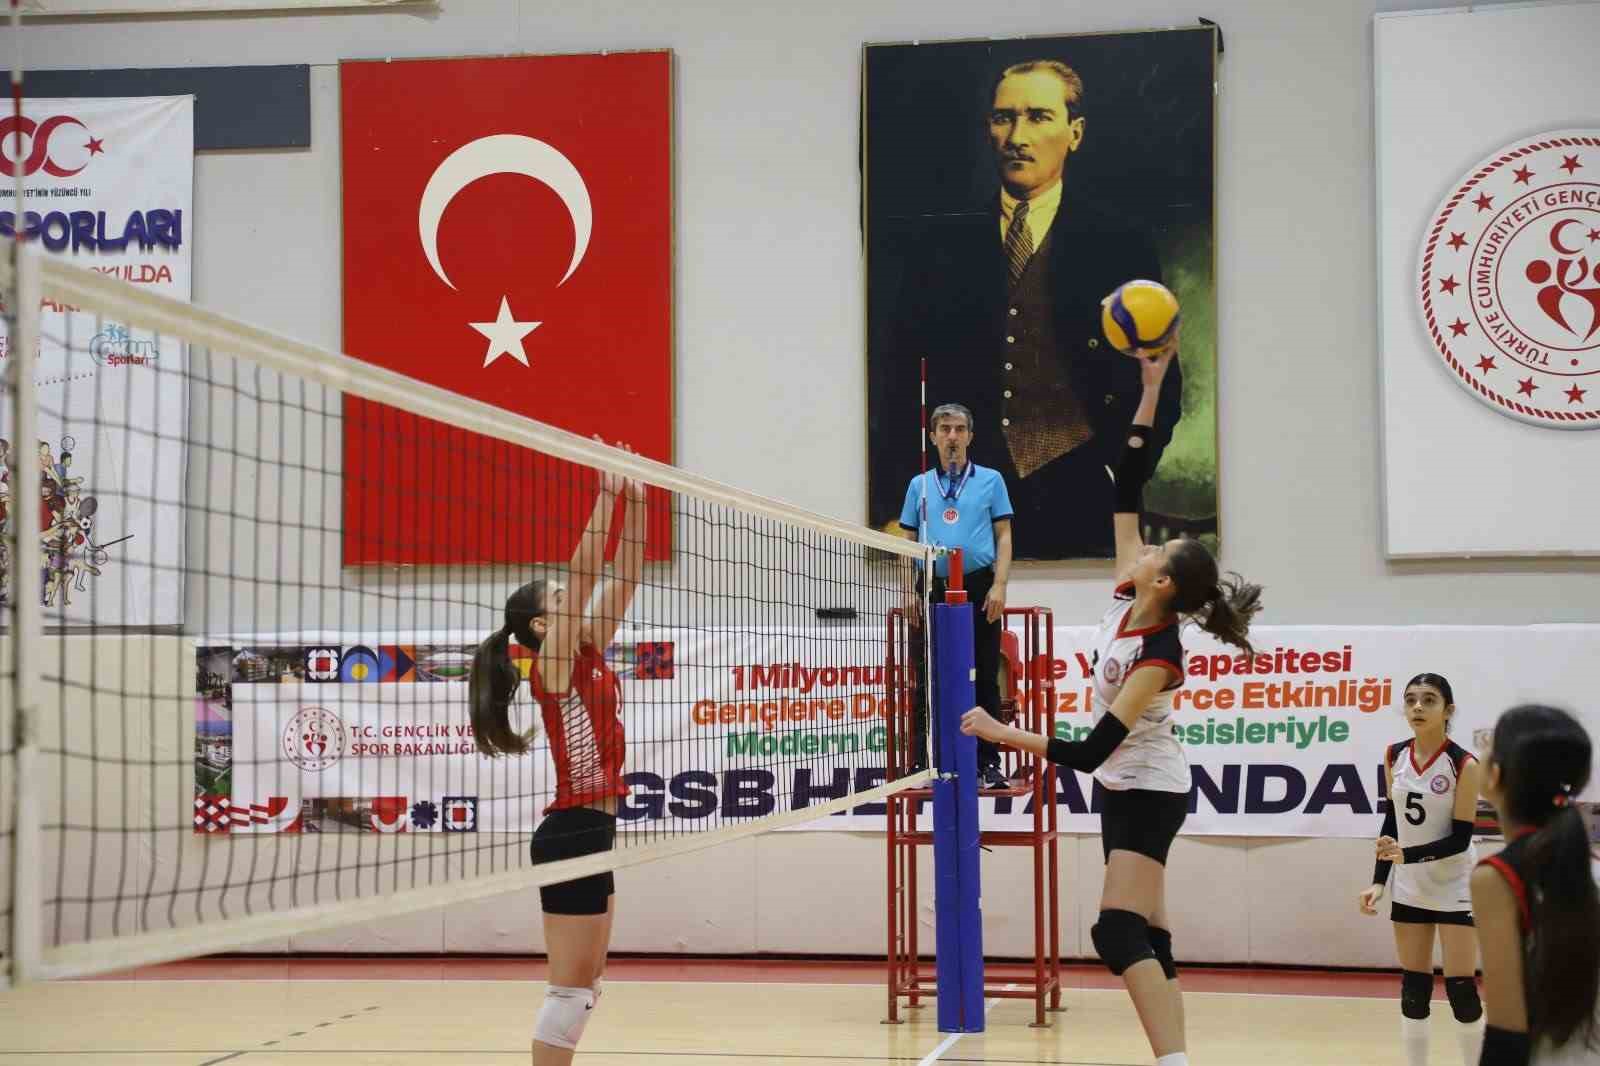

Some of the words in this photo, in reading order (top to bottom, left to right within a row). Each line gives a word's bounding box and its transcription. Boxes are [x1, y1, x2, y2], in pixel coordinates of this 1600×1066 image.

[1477, 197, 1540, 308] CUMHURİYETİ
[1486, 312, 1549, 366] TÜRKİYE
[751, 661, 900, 694] Milyonu
[1184, 645, 1353, 682] apasitesi
[1241, 677, 1392, 713] Etkinliği
[692, 697, 846, 730] Gençlere
[351, 726, 377, 738] T.C.
[382, 724, 450, 741] GENÇLİK
[351, 743, 390, 756] SPOR
[394, 740, 474, 756] BAKANLIĞI
[726, 728, 858, 757] Modern
[616, 769, 776, 821] GSB
[1404, 791, 1427, 827] 5
